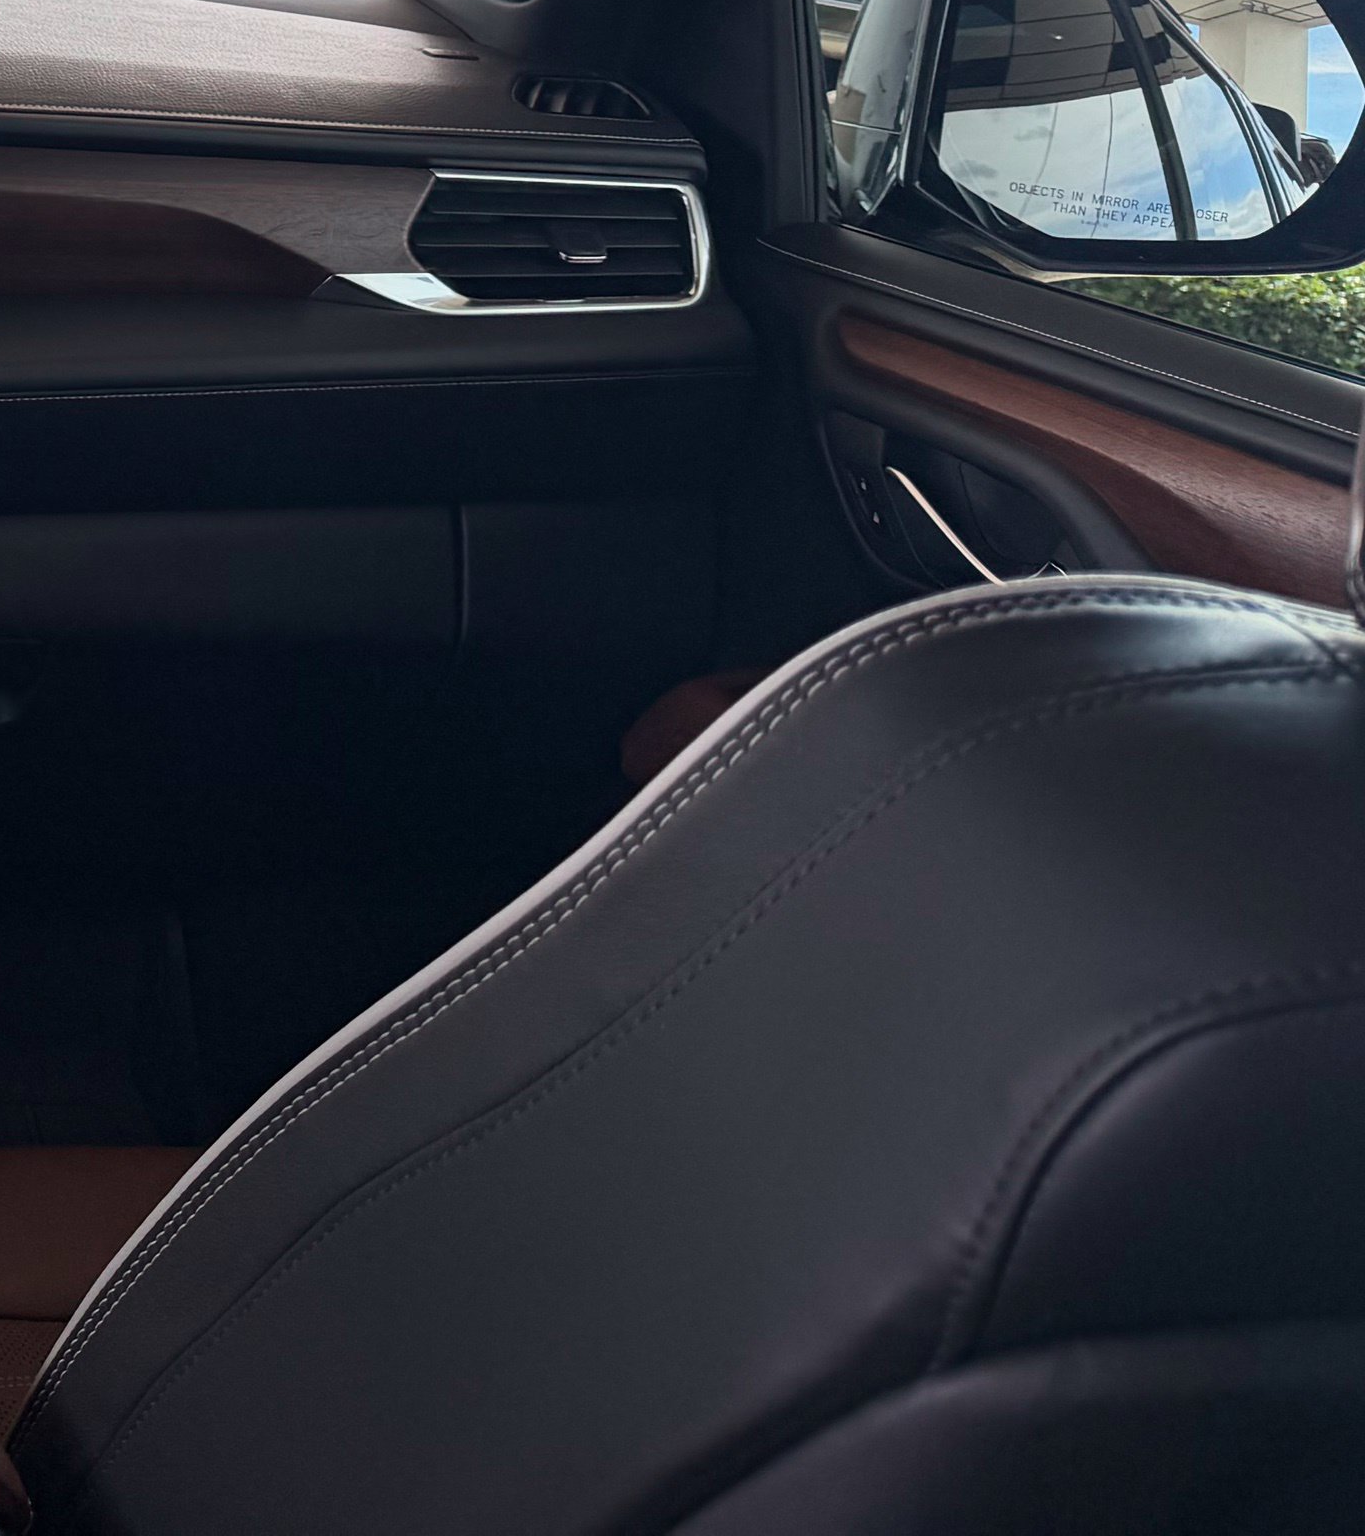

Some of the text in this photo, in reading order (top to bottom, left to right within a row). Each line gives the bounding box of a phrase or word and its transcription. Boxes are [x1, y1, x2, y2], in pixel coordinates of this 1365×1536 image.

[1009, 182, 1065, 199] OBJECTS
[1071, 191, 1084, 202] IN
[1092, 194, 1140, 211] MIRROR
[1147, 202, 1173, 215] ARE
[1053, 201, 1175, 229] THAN THEY APPEA
